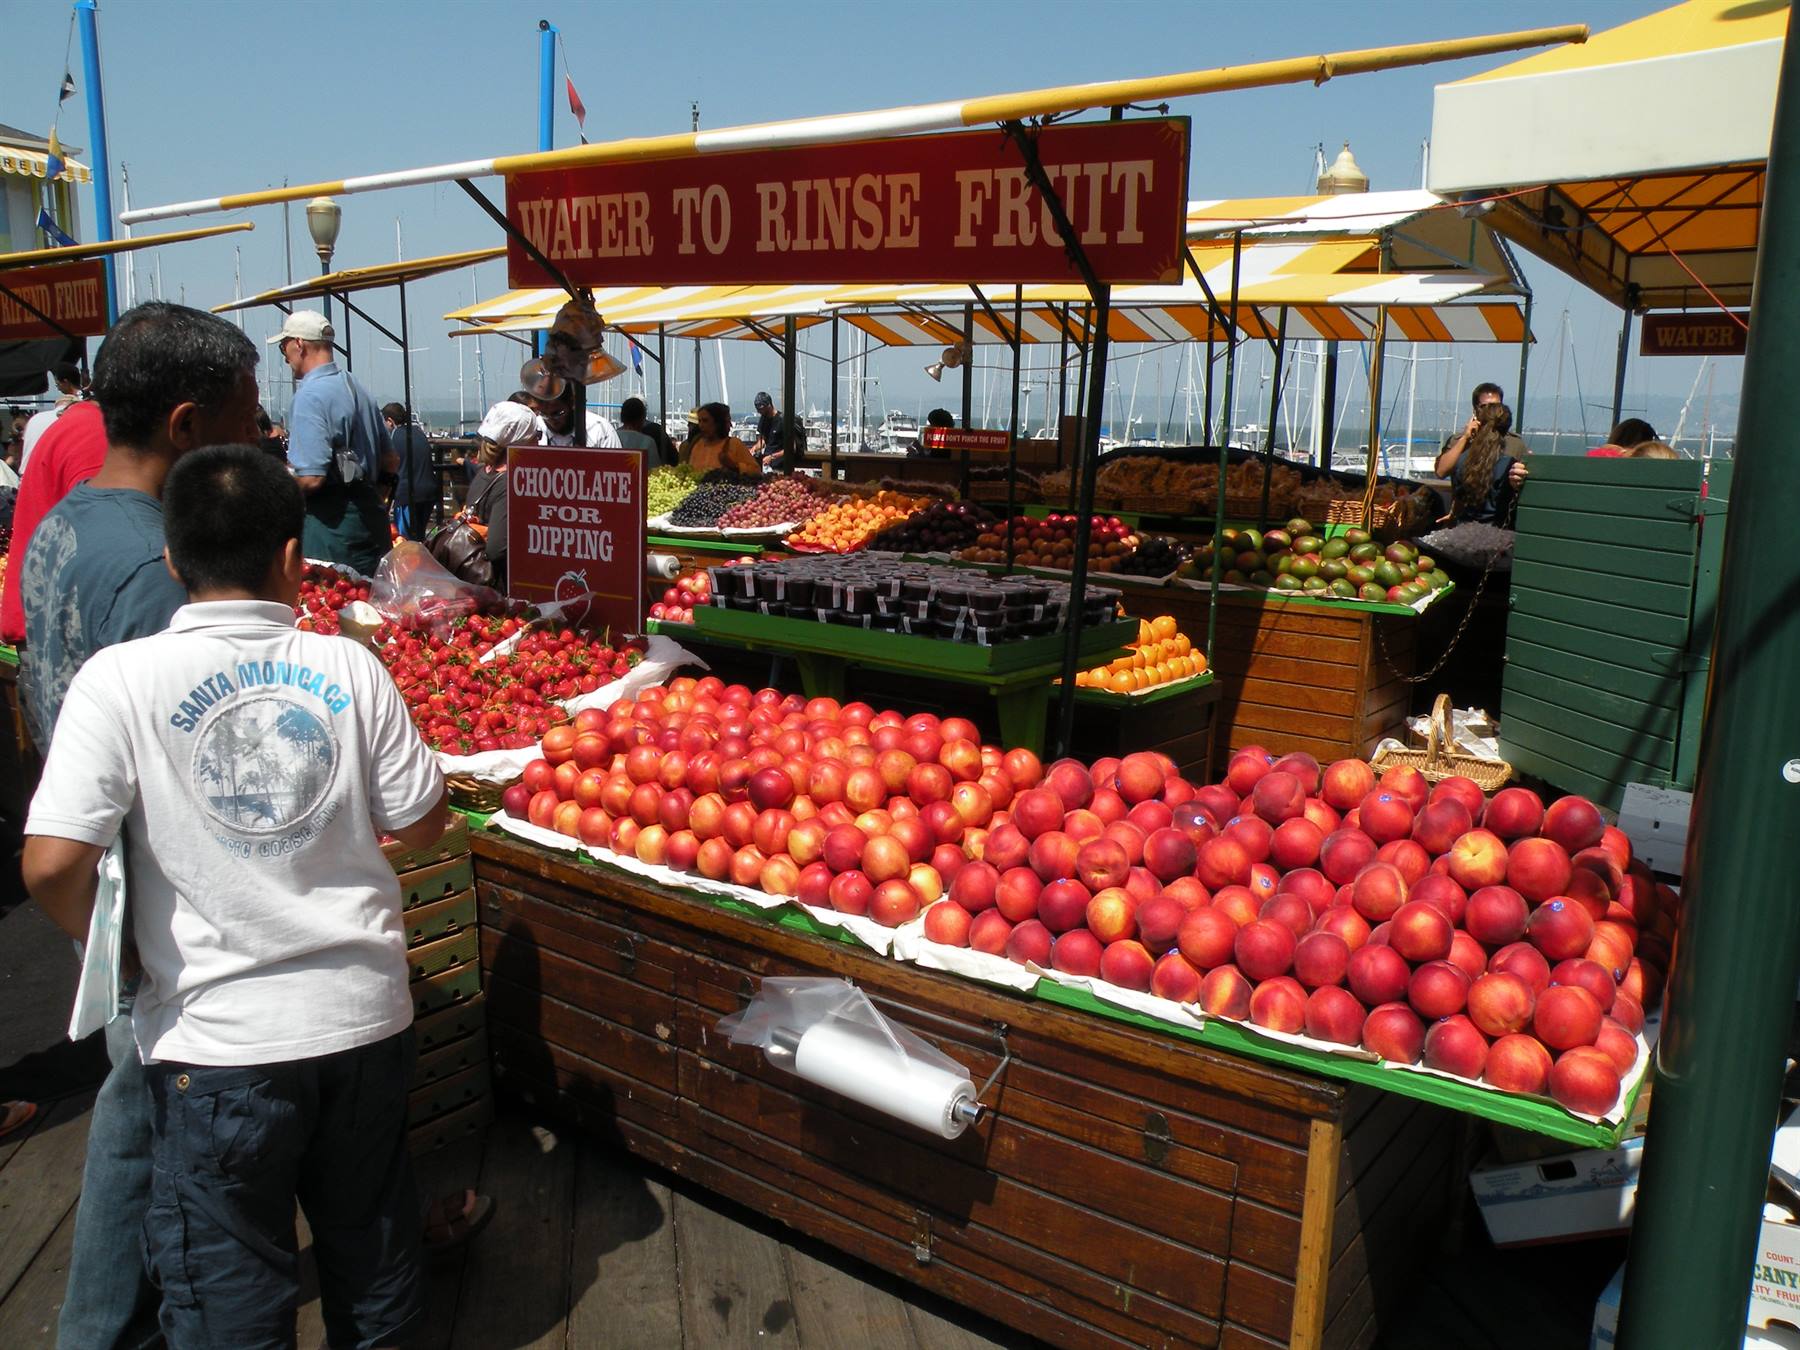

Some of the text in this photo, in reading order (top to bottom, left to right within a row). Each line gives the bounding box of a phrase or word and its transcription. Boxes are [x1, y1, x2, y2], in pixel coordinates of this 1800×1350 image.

[518, 160, 1154, 262] WATER TO RINSE FRUIT
[54, 278, 98, 320] FRUIT
[1656, 326, 1735, 347] WATER
[513, 466, 632, 503] CHOCOLATE
[538, 504, 602, 524] FOR
[527, 524, 614, 562] DIPPING
[170, 671, 235, 733] SANTA
[1766, 1251, 1793, 1264] COUNT
[1754, 1263, 1800, 1289] CANY
[1776, 1289, 1800, 1303] FRUI
